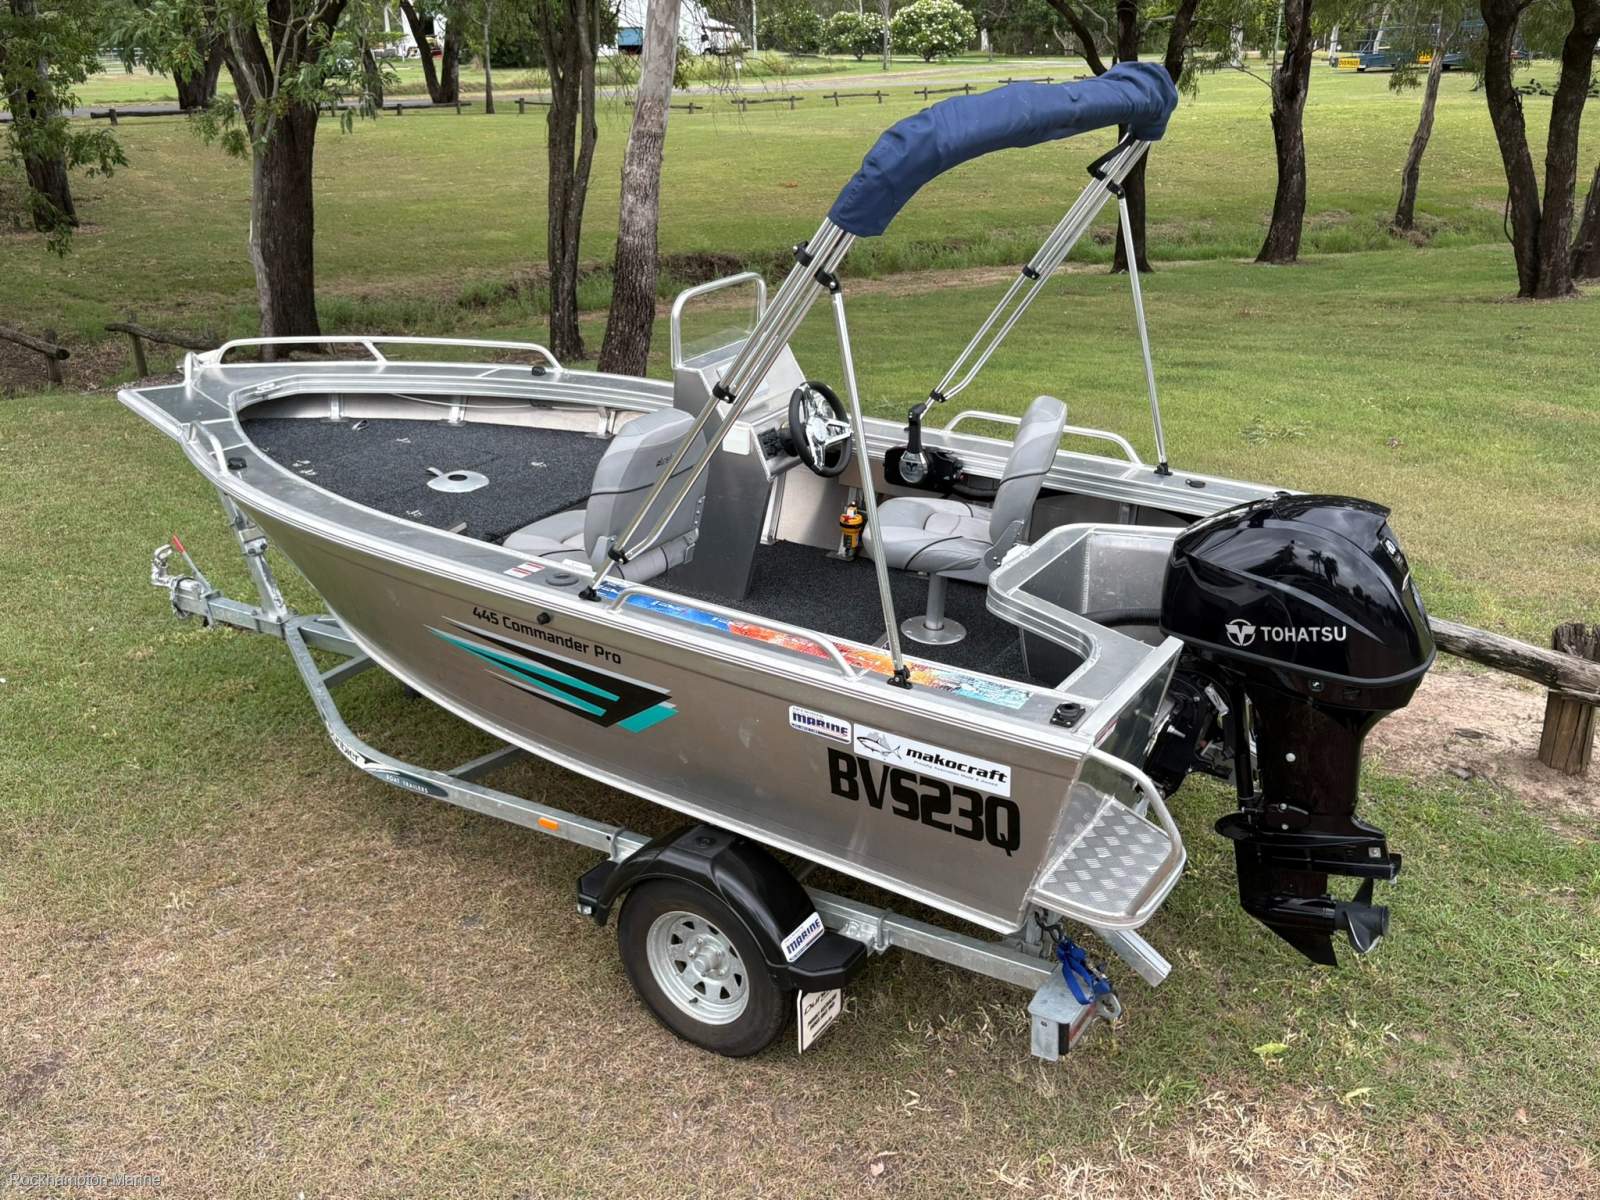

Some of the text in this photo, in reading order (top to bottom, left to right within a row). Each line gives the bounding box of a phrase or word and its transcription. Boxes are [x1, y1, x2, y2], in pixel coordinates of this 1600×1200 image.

[473, 607, 622, 665] 445 Commander Pro
[1260, 626, 1347, 642] TOHATSU
[792, 712, 848, 735] MARINE
[906, 748, 1008, 783] makocraft
[386, 774, 429, 794] BOAT TRAILERS
[827, 747, 1021, 857] BVS23Q
[786, 918, 822, 955] MARINE
